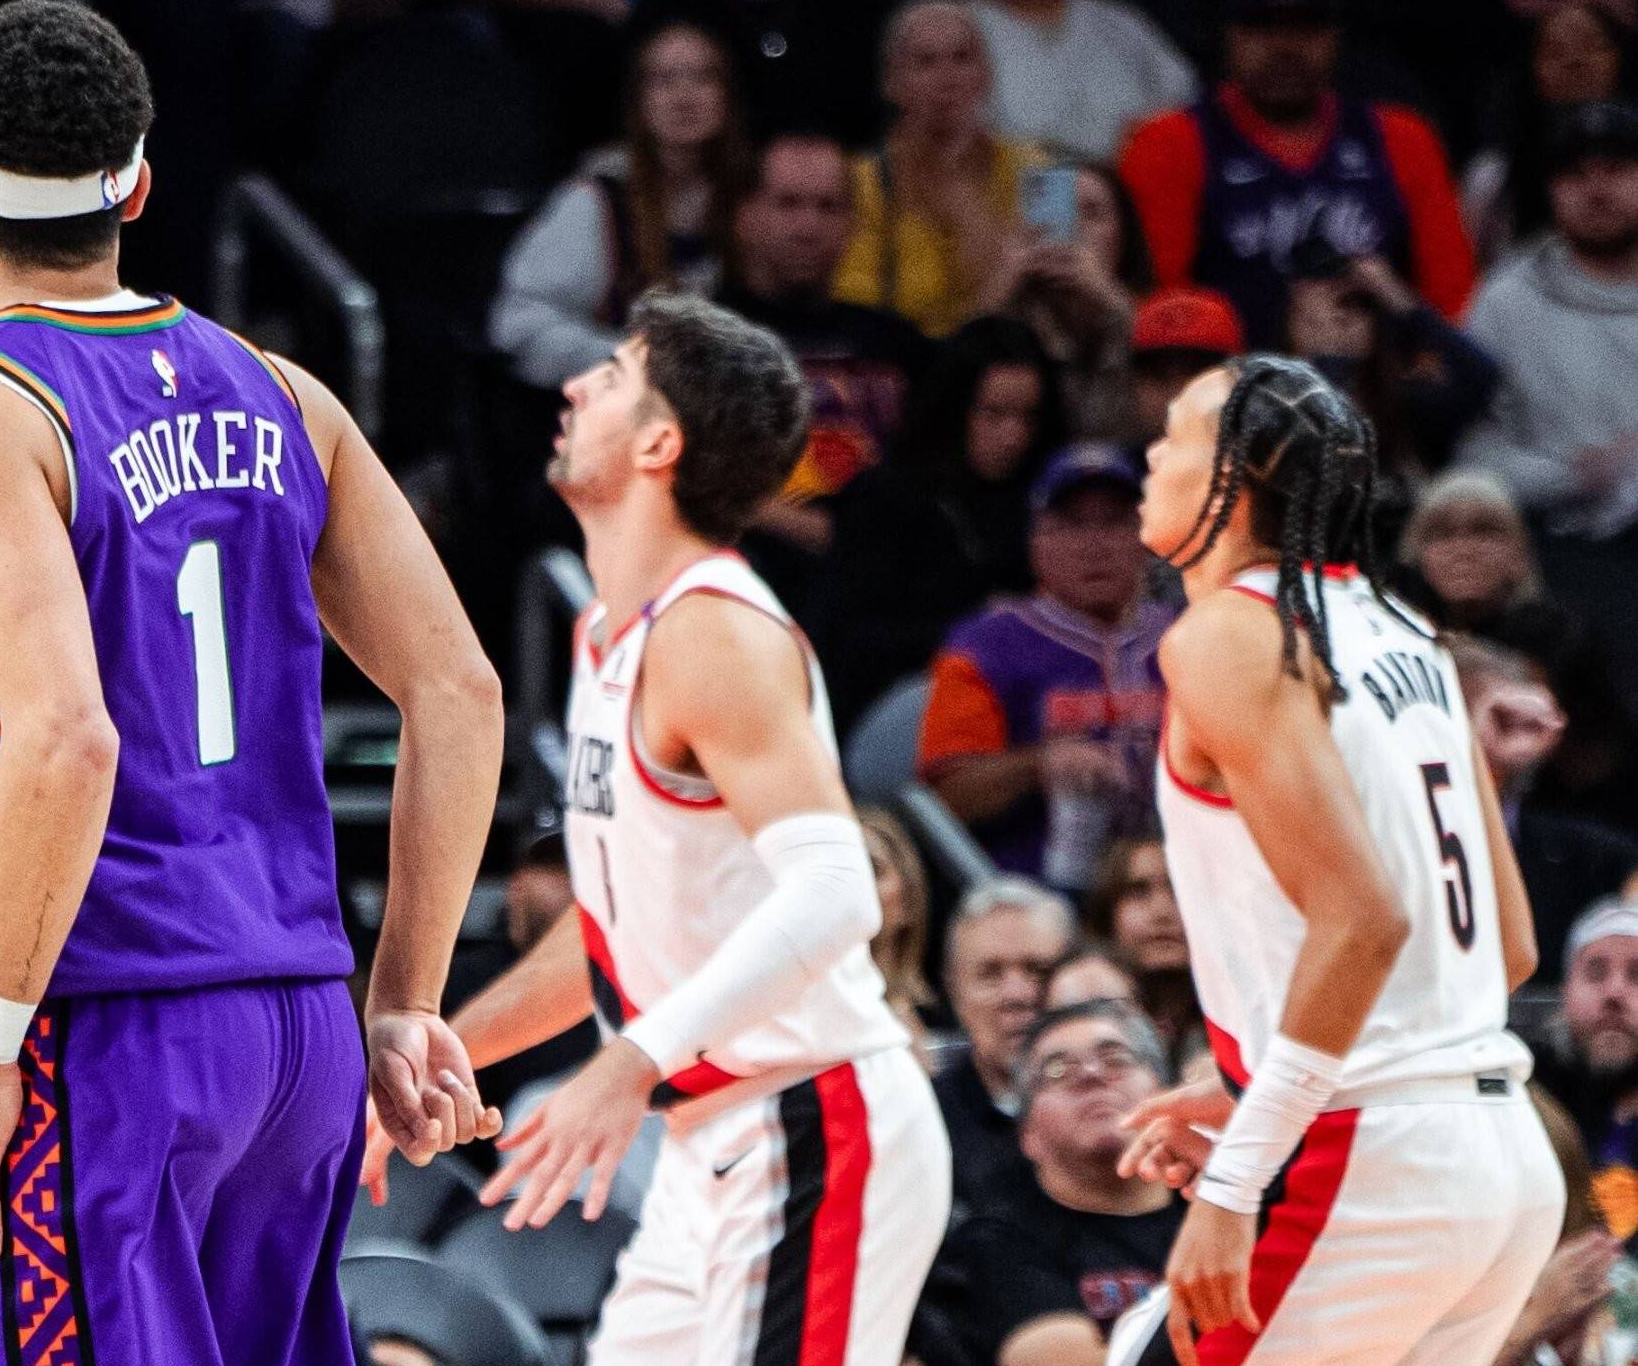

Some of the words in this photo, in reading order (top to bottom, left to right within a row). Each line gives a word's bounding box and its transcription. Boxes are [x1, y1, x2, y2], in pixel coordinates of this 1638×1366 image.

[109, 410, 285, 524] BOOKER
[176, 539, 235, 767] 1
[1418, 762, 1475, 952] 5
